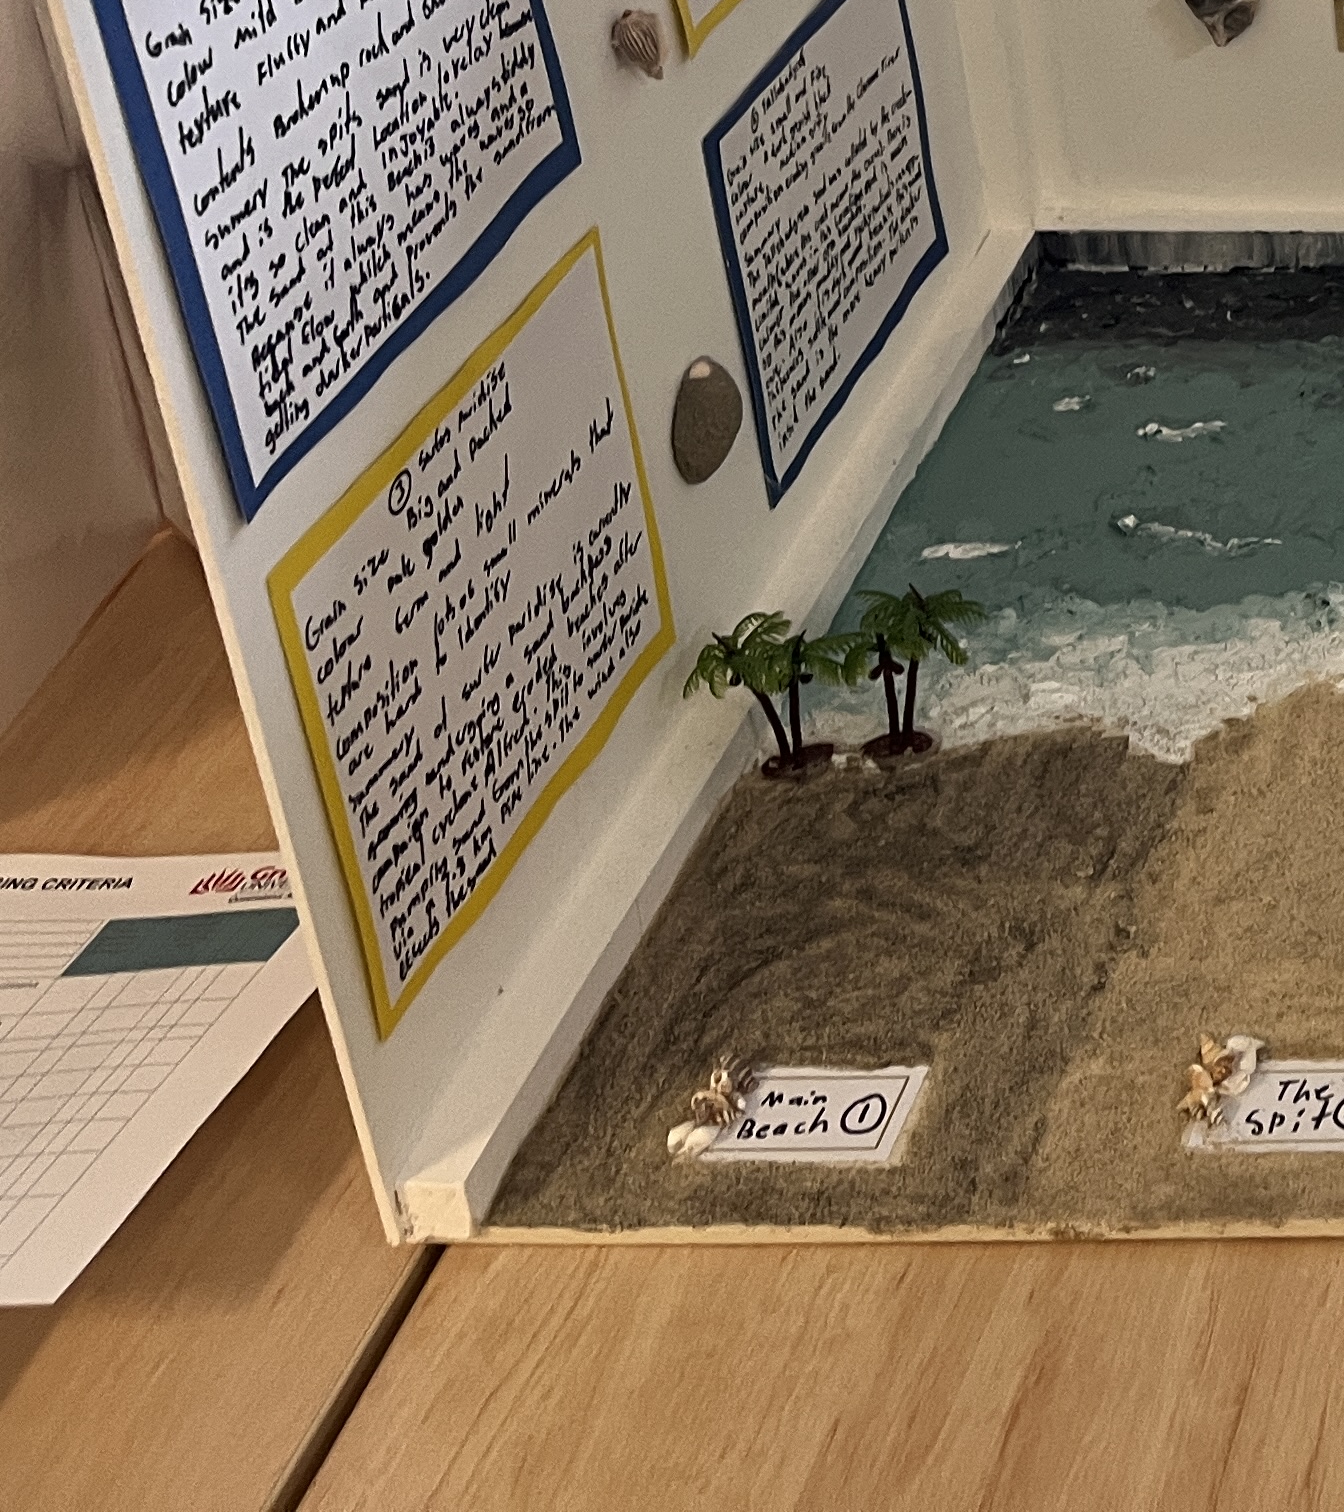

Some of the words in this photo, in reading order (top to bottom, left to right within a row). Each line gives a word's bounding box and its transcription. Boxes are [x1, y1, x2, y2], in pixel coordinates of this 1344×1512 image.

[391, 0, 415, 45] and
[221, 232, 250, 281] and
[437, 449, 461, 497] and
[0, 877, 38, 890] ING
[42, 876, 133, 890] CRITERIA
[761, 1090, 827, 1108] Main
[1278, 1079, 1334, 1104] The
[737, 1107, 828, 1139] Beach
[1245, 1098, 1332, 1136] Spit
